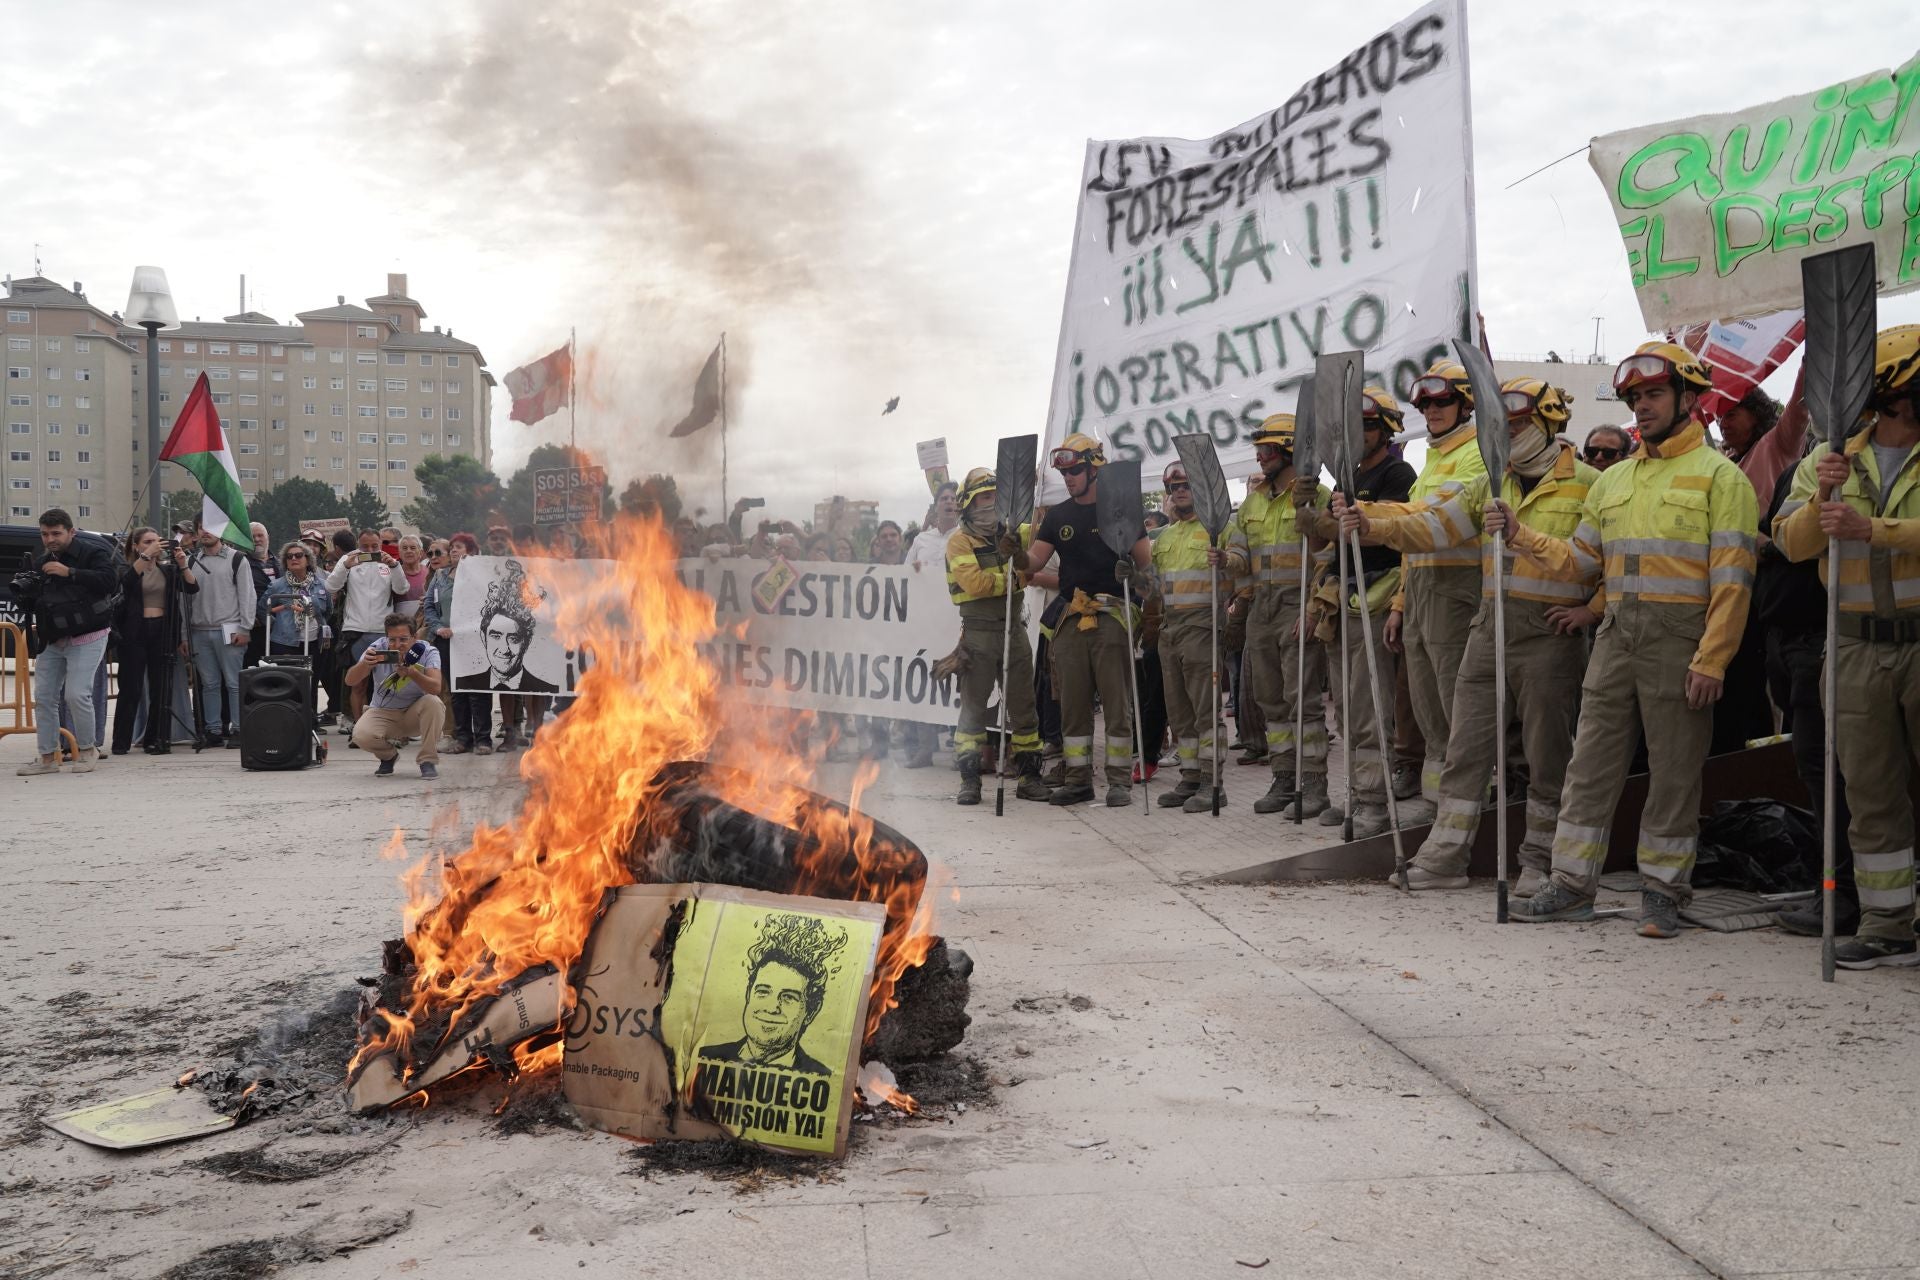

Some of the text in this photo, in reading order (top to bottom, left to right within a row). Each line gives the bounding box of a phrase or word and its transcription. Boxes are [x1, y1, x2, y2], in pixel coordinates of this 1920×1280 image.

[1105, 107, 1392, 254] FORESTALES
[1111, 399, 1265, 463] SOMOS
[537, 474, 565, 490] SOS
[570, 472, 597, 488] SOS
[514, 996, 530, 1030] Smart
[591, 1063, 640, 1083] Packaging
[794, 1110, 826, 1140] YA!
